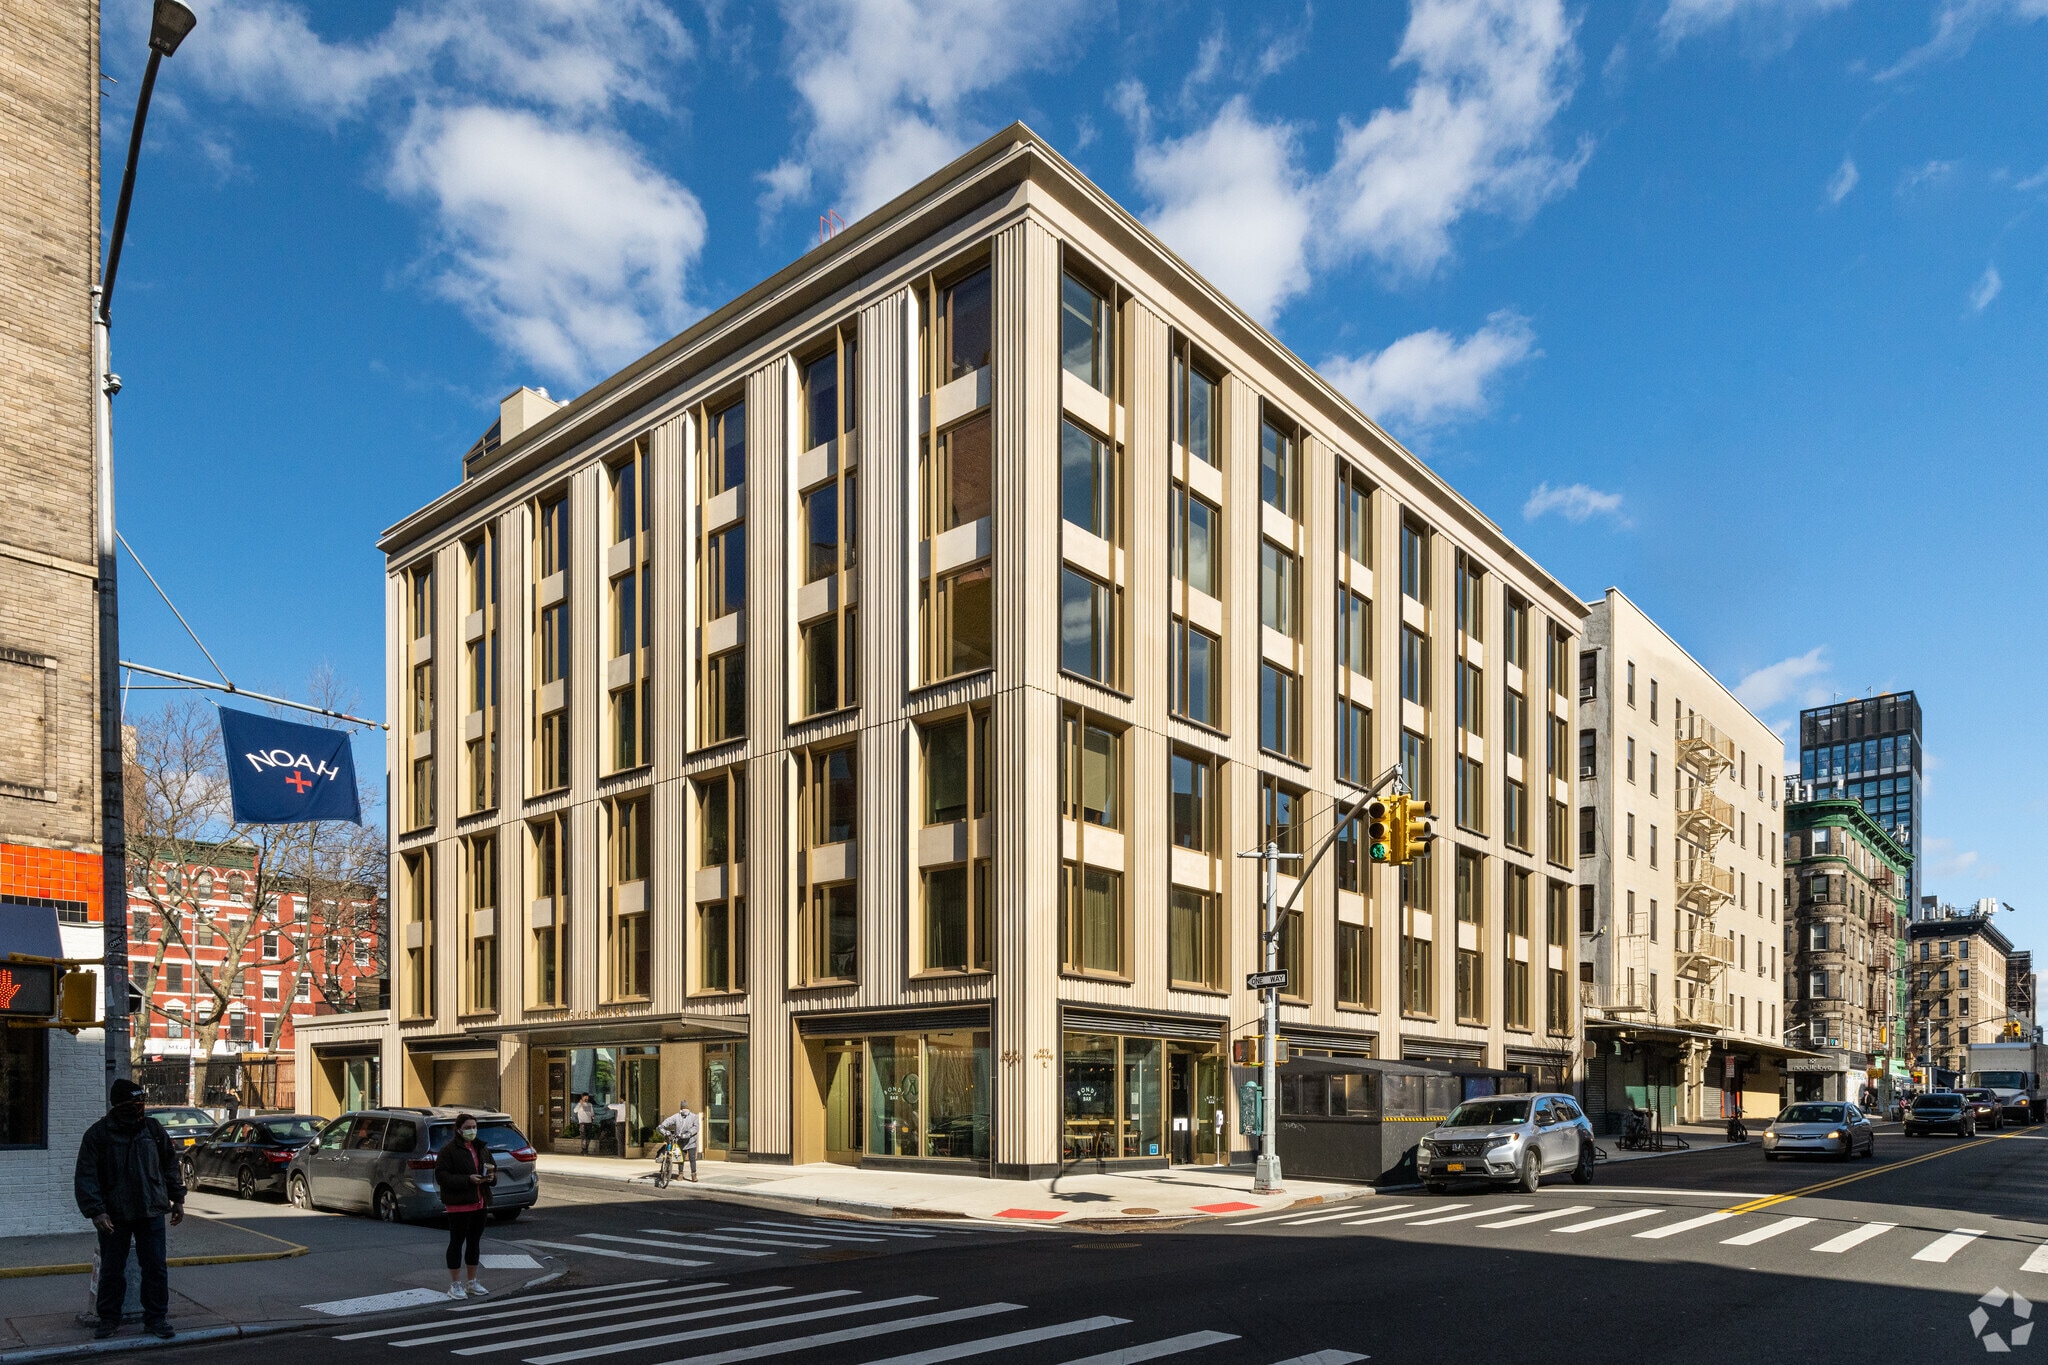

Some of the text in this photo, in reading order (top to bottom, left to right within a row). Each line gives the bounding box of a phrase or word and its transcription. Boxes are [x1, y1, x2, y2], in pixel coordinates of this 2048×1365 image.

[245, 749, 340, 781] NOAH
[1252, 975, 1284, 985] ONE WAY
[883, 1086, 905, 1096] BONDI
[1077, 1086, 1097, 1097] BONDI
